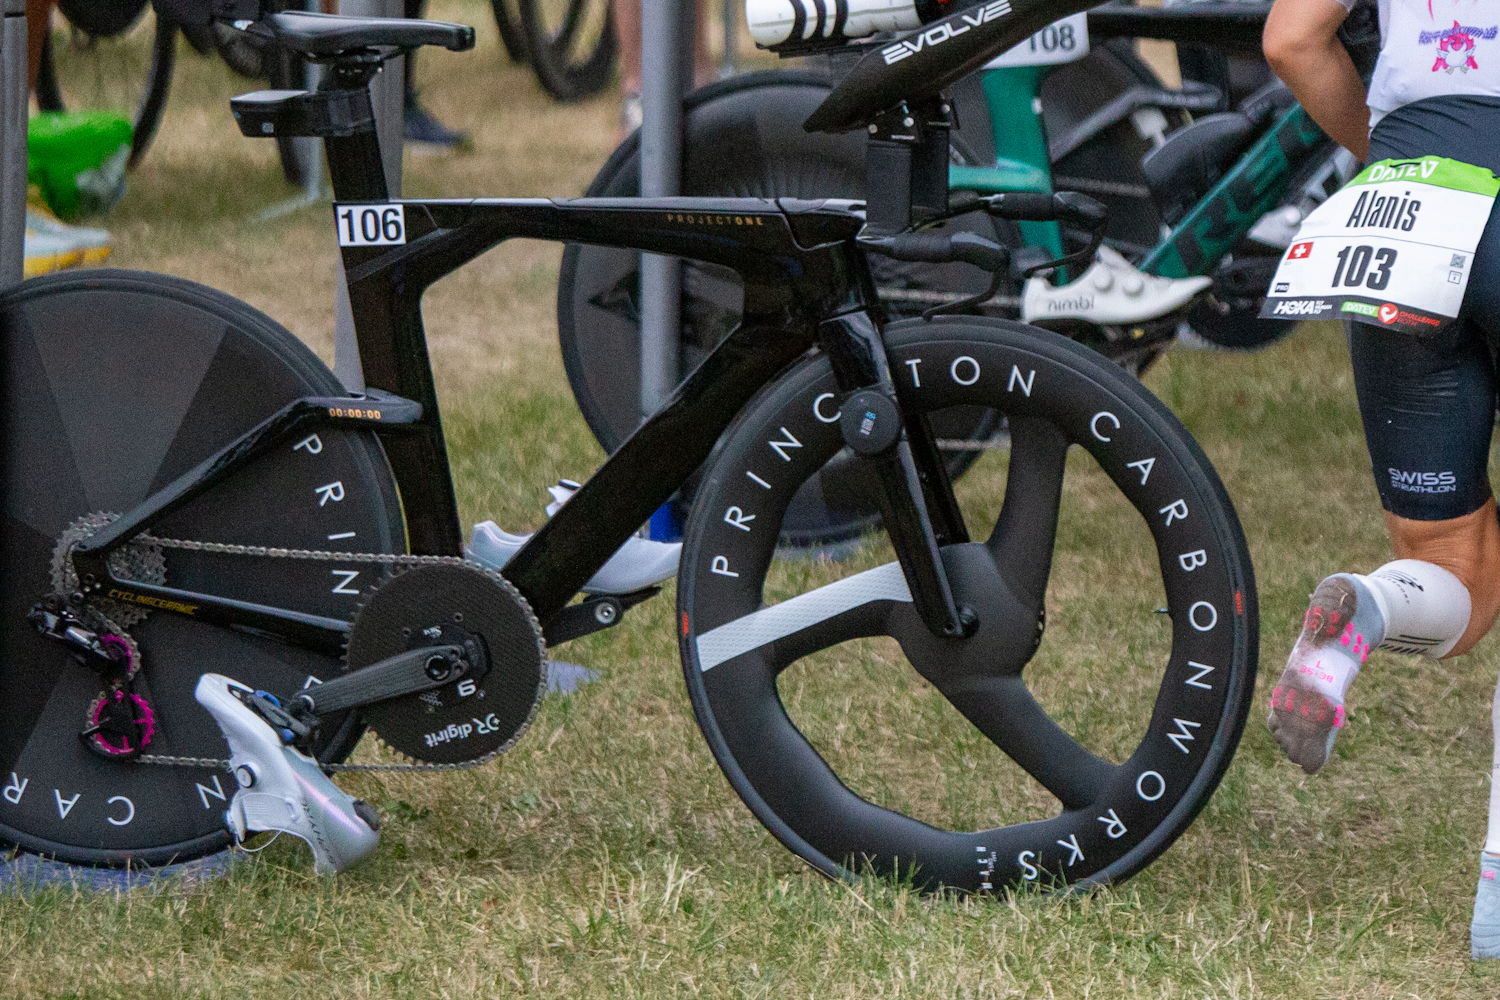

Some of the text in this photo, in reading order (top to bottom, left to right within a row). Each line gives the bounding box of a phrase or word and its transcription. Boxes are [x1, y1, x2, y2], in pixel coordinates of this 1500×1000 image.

[1367, 160, 1439, 183] DATEV
[1345, 190, 1421, 232] Alanis
[341, 208, 402, 243] 106
[1331, 245, 1398, 291] 103
[1047, 295, 1095, 312] nimbl
[1273, 301, 1316, 315] HOKA
[329, 407, 382, 420] 00:00:00
[711, 355, 1036, 578] PRINCTON
[1387, 467, 1456, 486] SWISS
